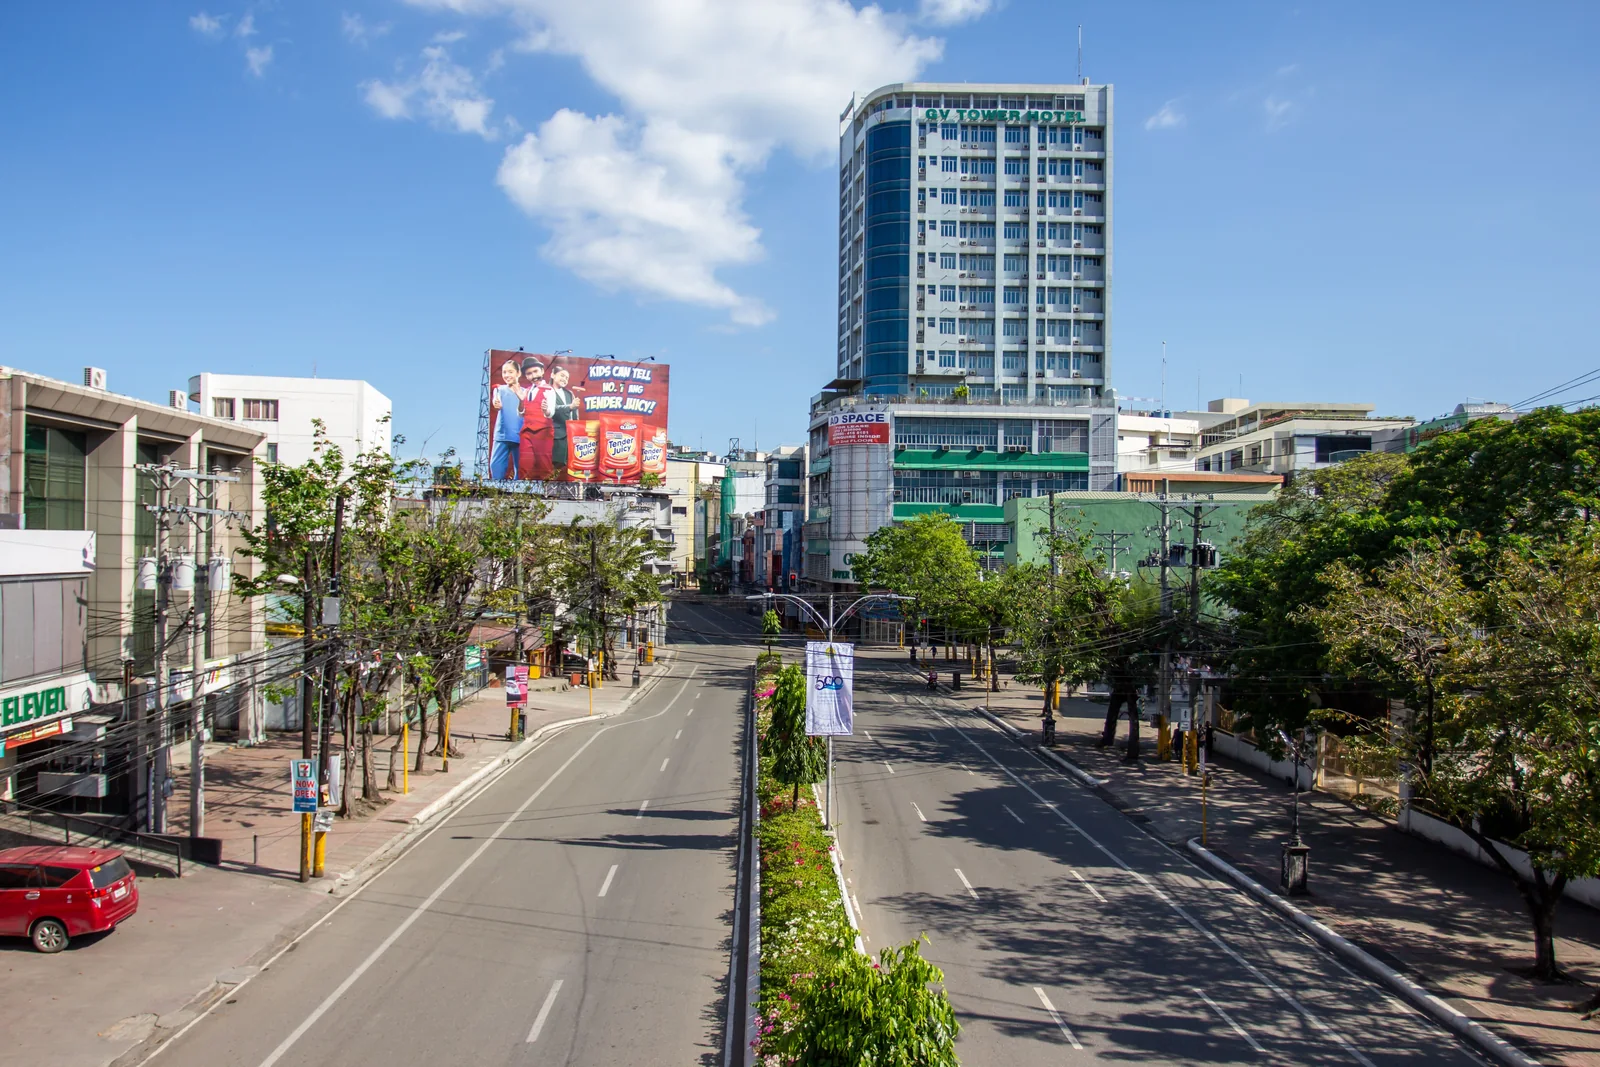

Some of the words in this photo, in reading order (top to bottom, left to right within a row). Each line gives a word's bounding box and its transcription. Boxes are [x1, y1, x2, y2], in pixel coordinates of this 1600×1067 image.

[925, 109, 950, 120] GV
[956, 109, 1020, 121] TOWER
[1027, 111, 1086, 122] HOTEL
[589, 365, 611, 378] KIDS
[612, 366, 631, 378] CAN
[632, 367, 651, 381] TELL
[602, 382, 618, 393] NO.
[627, 384, 644, 394] ANG
[584, 396, 623, 410] TENDER
[623, 397, 656, 414] JUICY!
[830, 416, 839, 425] AD
[841, 413, 885, 423] SPACE
[575, 440, 598, 451] Tender
[608, 437, 634, 448] Tender
[579, 447, 597, 458] Juicy
[612, 444, 632, 456] Juicy
[641, 448, 662, 456] Tender
[643, 452, 660, 462] Juicy
[295, 780, 315, 788] NOW
[294, 789, 317, 798] OPEN
